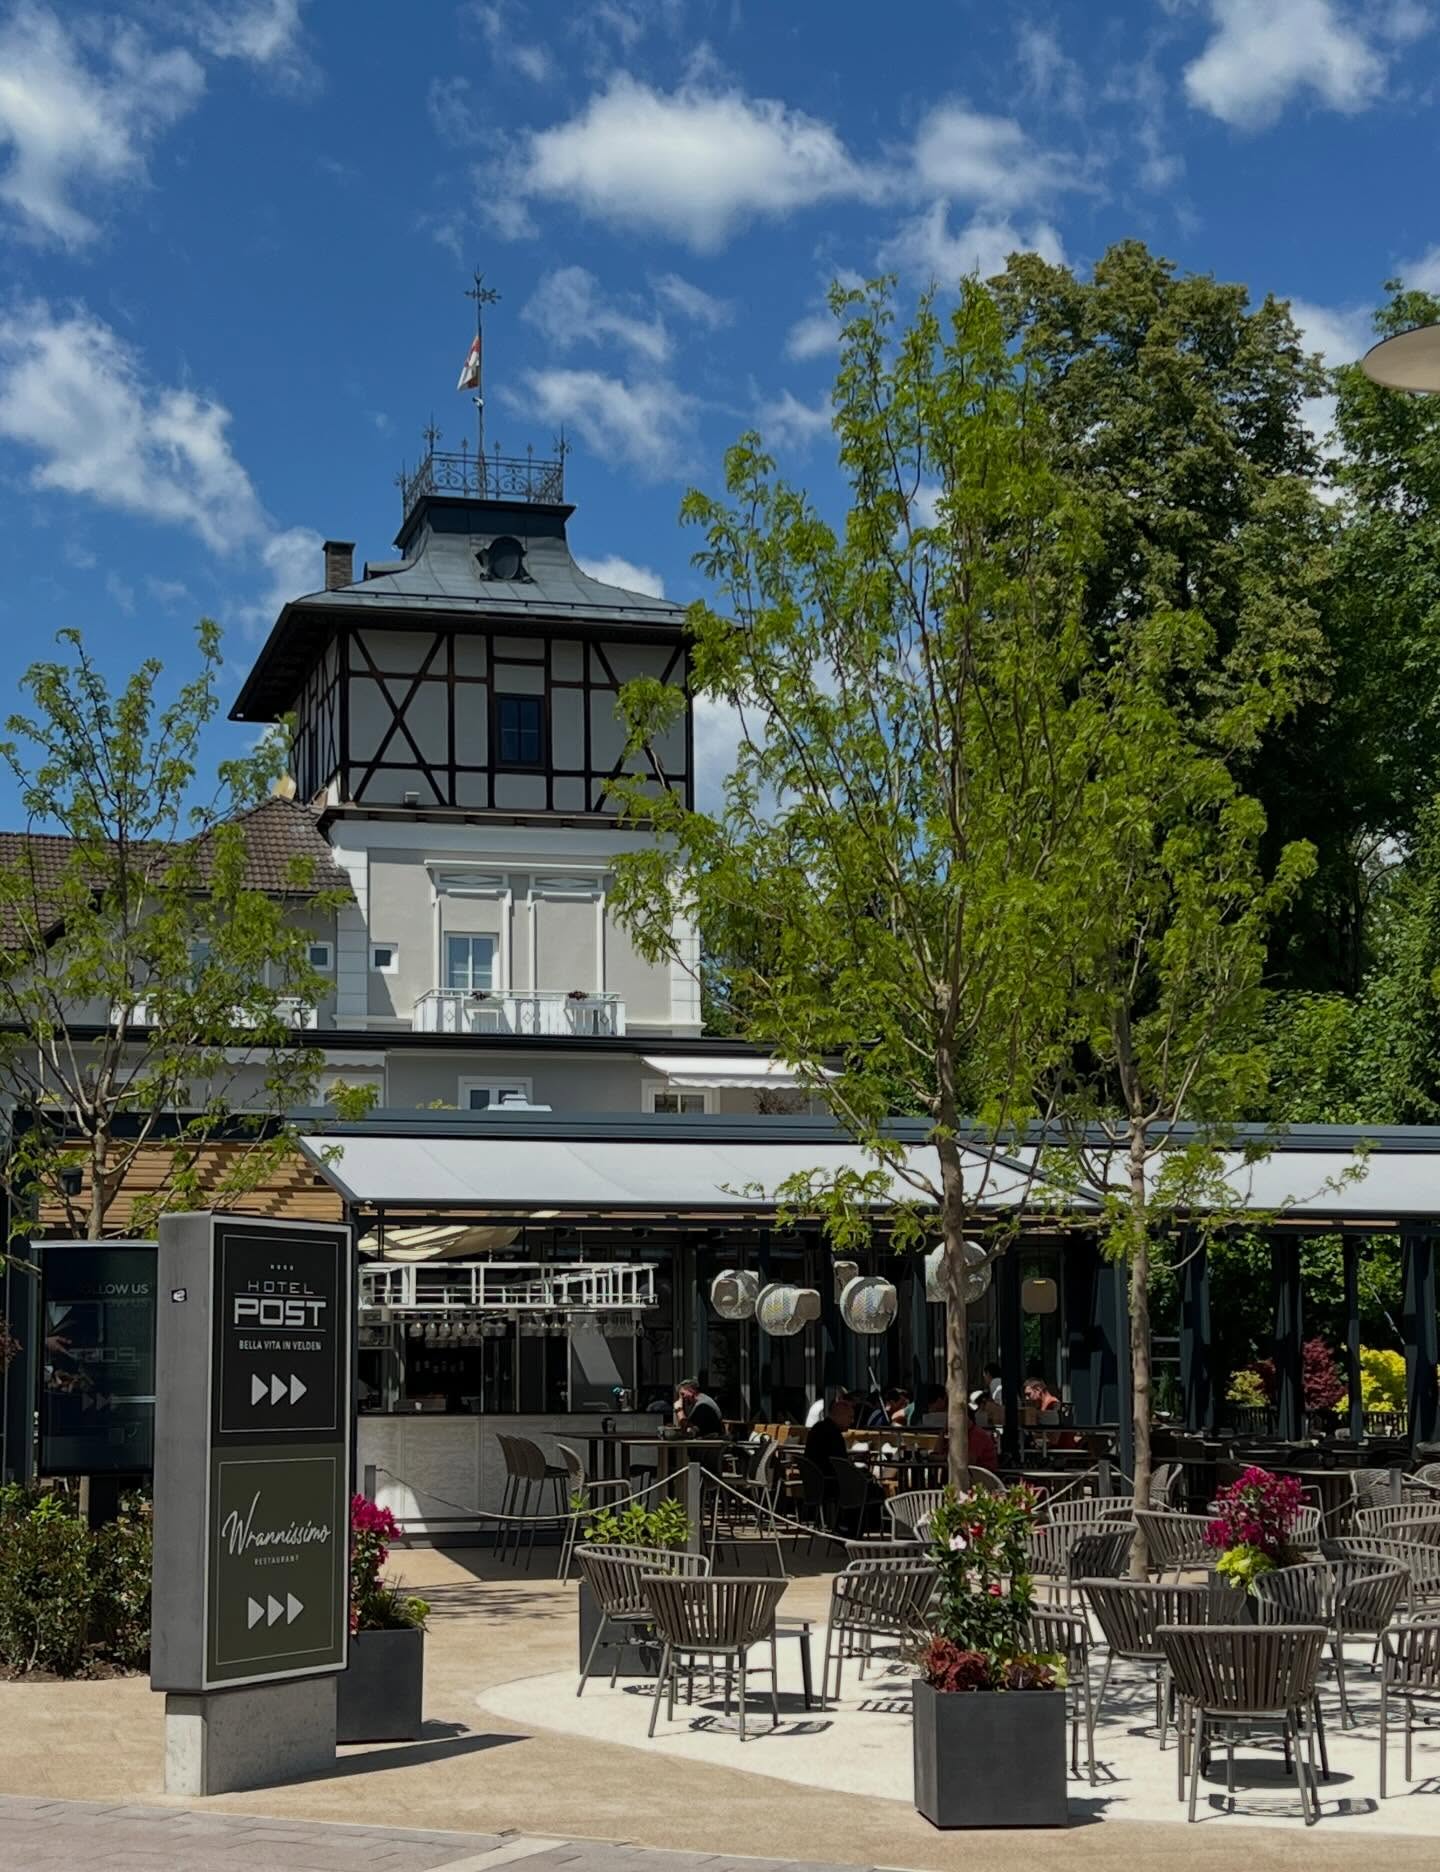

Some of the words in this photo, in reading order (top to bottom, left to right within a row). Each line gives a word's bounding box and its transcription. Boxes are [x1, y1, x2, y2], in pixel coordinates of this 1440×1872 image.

[131, 1283, 150, 1295] US
[247, 1280, 314, 1295] HOTEL
[234, 1298, 327, 1327] POST
[239, 1340, 262, 1350] BELLA
[264, 1340, 281, 1350] VITA
[282, 1340, 291, 1350] IN
[293, 1341, 322, 1351] VELDEN
[222, 1491, 331, 1555] Wrannissimo
[254, 1554, 300, 1566] RESTAURANT
